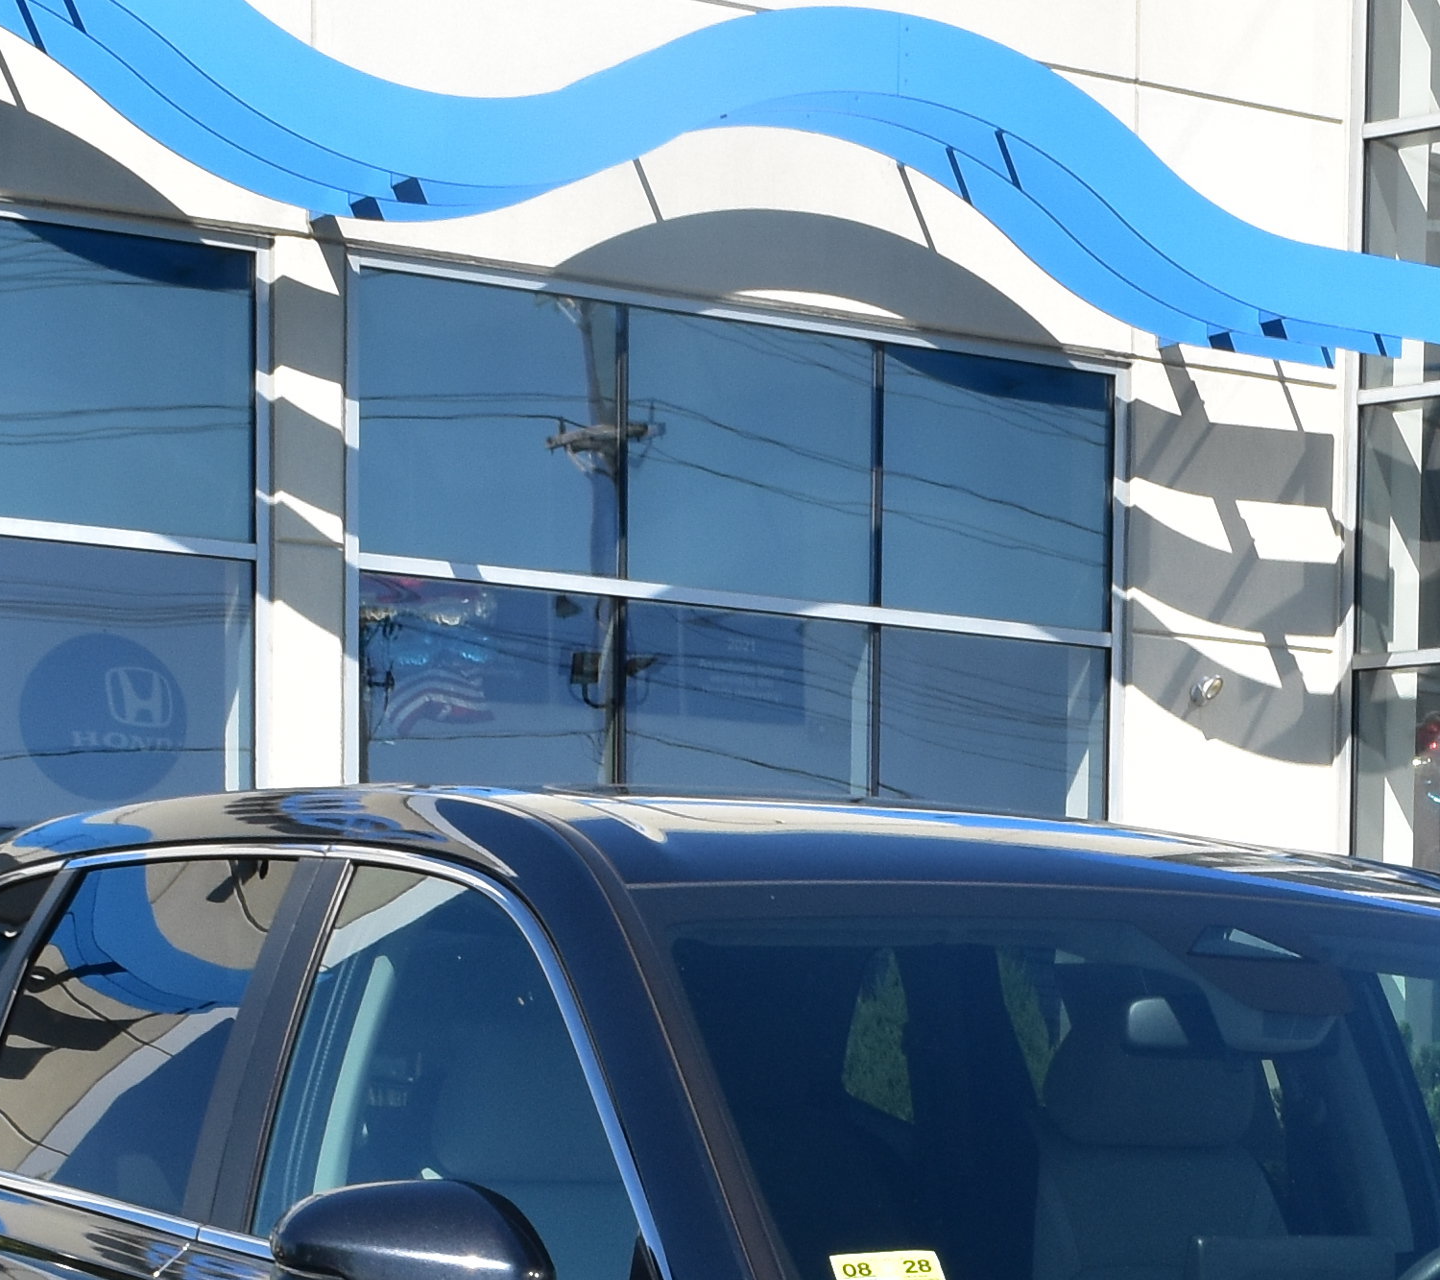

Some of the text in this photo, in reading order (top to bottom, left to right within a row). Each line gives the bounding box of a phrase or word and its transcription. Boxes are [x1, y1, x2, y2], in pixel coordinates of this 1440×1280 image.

[71, 730, 183, 749] HOND
[842, 1259, 932, 1277] 08 28
